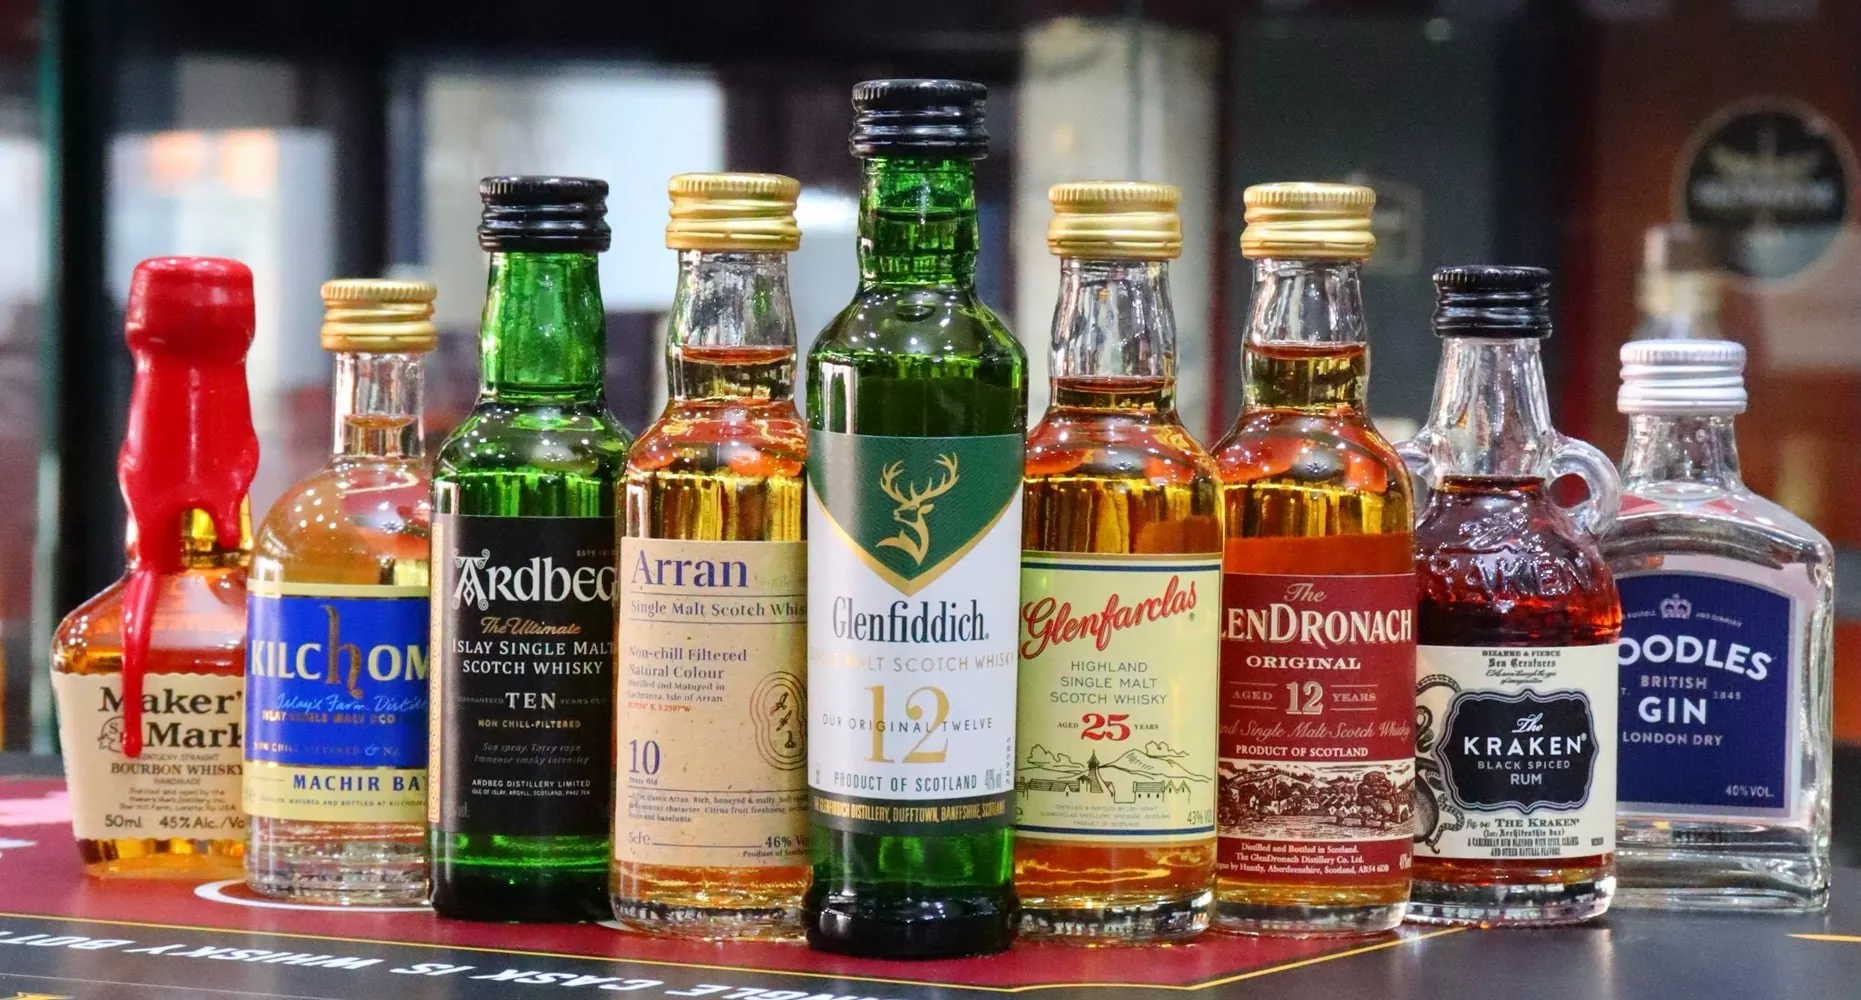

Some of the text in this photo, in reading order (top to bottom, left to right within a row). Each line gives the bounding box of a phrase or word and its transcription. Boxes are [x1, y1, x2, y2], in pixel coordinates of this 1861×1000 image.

[631, 549, 749, 588] Arran
[1284, 582, 1328, 602] The
[631, 600, 666, 618] Single
[671, 601, 706, 617] Malt
[711, 602, 765, 617] Scotch
[1021, 575, 1197, 660] Glenfarclas
[480, 616, 581, 635] The Ultimate
[832, 596, 986, 644] Glenfiddich
[452, 638, 614, 656] ISLAY SINGLE MALT
[629, 645, 748, 662] Non-chill Filtered
[462, 660, 603, 675] SCOTCH WHISKY
[893, 657, 969, 673] SCOTCH
[975, 652, 1015, 669] WHISKY
[1071, 660, 1148, 673] HIGHLAND
[1246, 655, 1361, 670] ORIGINAL
[629, 664, 725, 680] Natural Colour
[1060, 676, 1158, 689] SINGLE MALT
[1640, 675, 1708, 690] BRITISH
[505, 692, 557, 709] TEN
[695, 694, 723, 703] Arran
[1050, 692, 1167, 705] SCOTCH WHISKY
[1232, 680, 1377, 715] AGED 12 YEARS
[1638, 696, 1707, 725] GIN
[478, 719, 581, 728] NON CHILL-FILTERED
[822, 713, 993, 733] OUR ORIGINAL TWELVE
[864, 685, 950, 764] 12
[1057, 721, 1079, 729] AGED
[1081, 713, 1130, 741] 25
[1240, 719, 1287, 742] Single
[1287, 721, 1330, 738] Malt
[1330, 721, 1375, 739] Scotch
[1511, 712, 1544, 734] The
[1463, 735, 1584, 757] KRAKEN
[1622, 731, 1723, 746] LONDON DRY
[629, 739, 660, 775] 10
[1236, 745, 1368, 758] PRODUCT OF SCOTLAND
[111, 763, 244, 776] BOURBON WHISKY
[1477, 760, 1571, 770] BLACK SPICED
[293, 775, 380, 792] MACHIR
[472, 779, 591, 788] ARDBEG DISTILLERY LIMITED
[834, 771, 882, 791] PRODUCT
[890, 777, 908, 791] OF
[915, 775, 977, 792] SCOTLAND
[1510, 773, 1542, 785] RUM
[1725, 784, 1775, 797] 40% VOL.
[105, 814, 142, 829] 50ml
[158, 815, 191, 829] 45%
[1494, 818, 1523, 828] THE
[765, 835, 792, 848] 46%
[1241, 842, 1271, 853] Distilled
[1272, 844, 1287, 853] and
[1288, 843, 1316, 853] Bottled
[1317, 844, 1325, 853] in
[1250, 853, 1299, 863] GlenDronach
[1301, 853, 1335, 865] Distillery
[122, 944, 385, 971] WHISKY
[389, 963, 476, 976] IS
[467, 968, 665, 992] CASK
